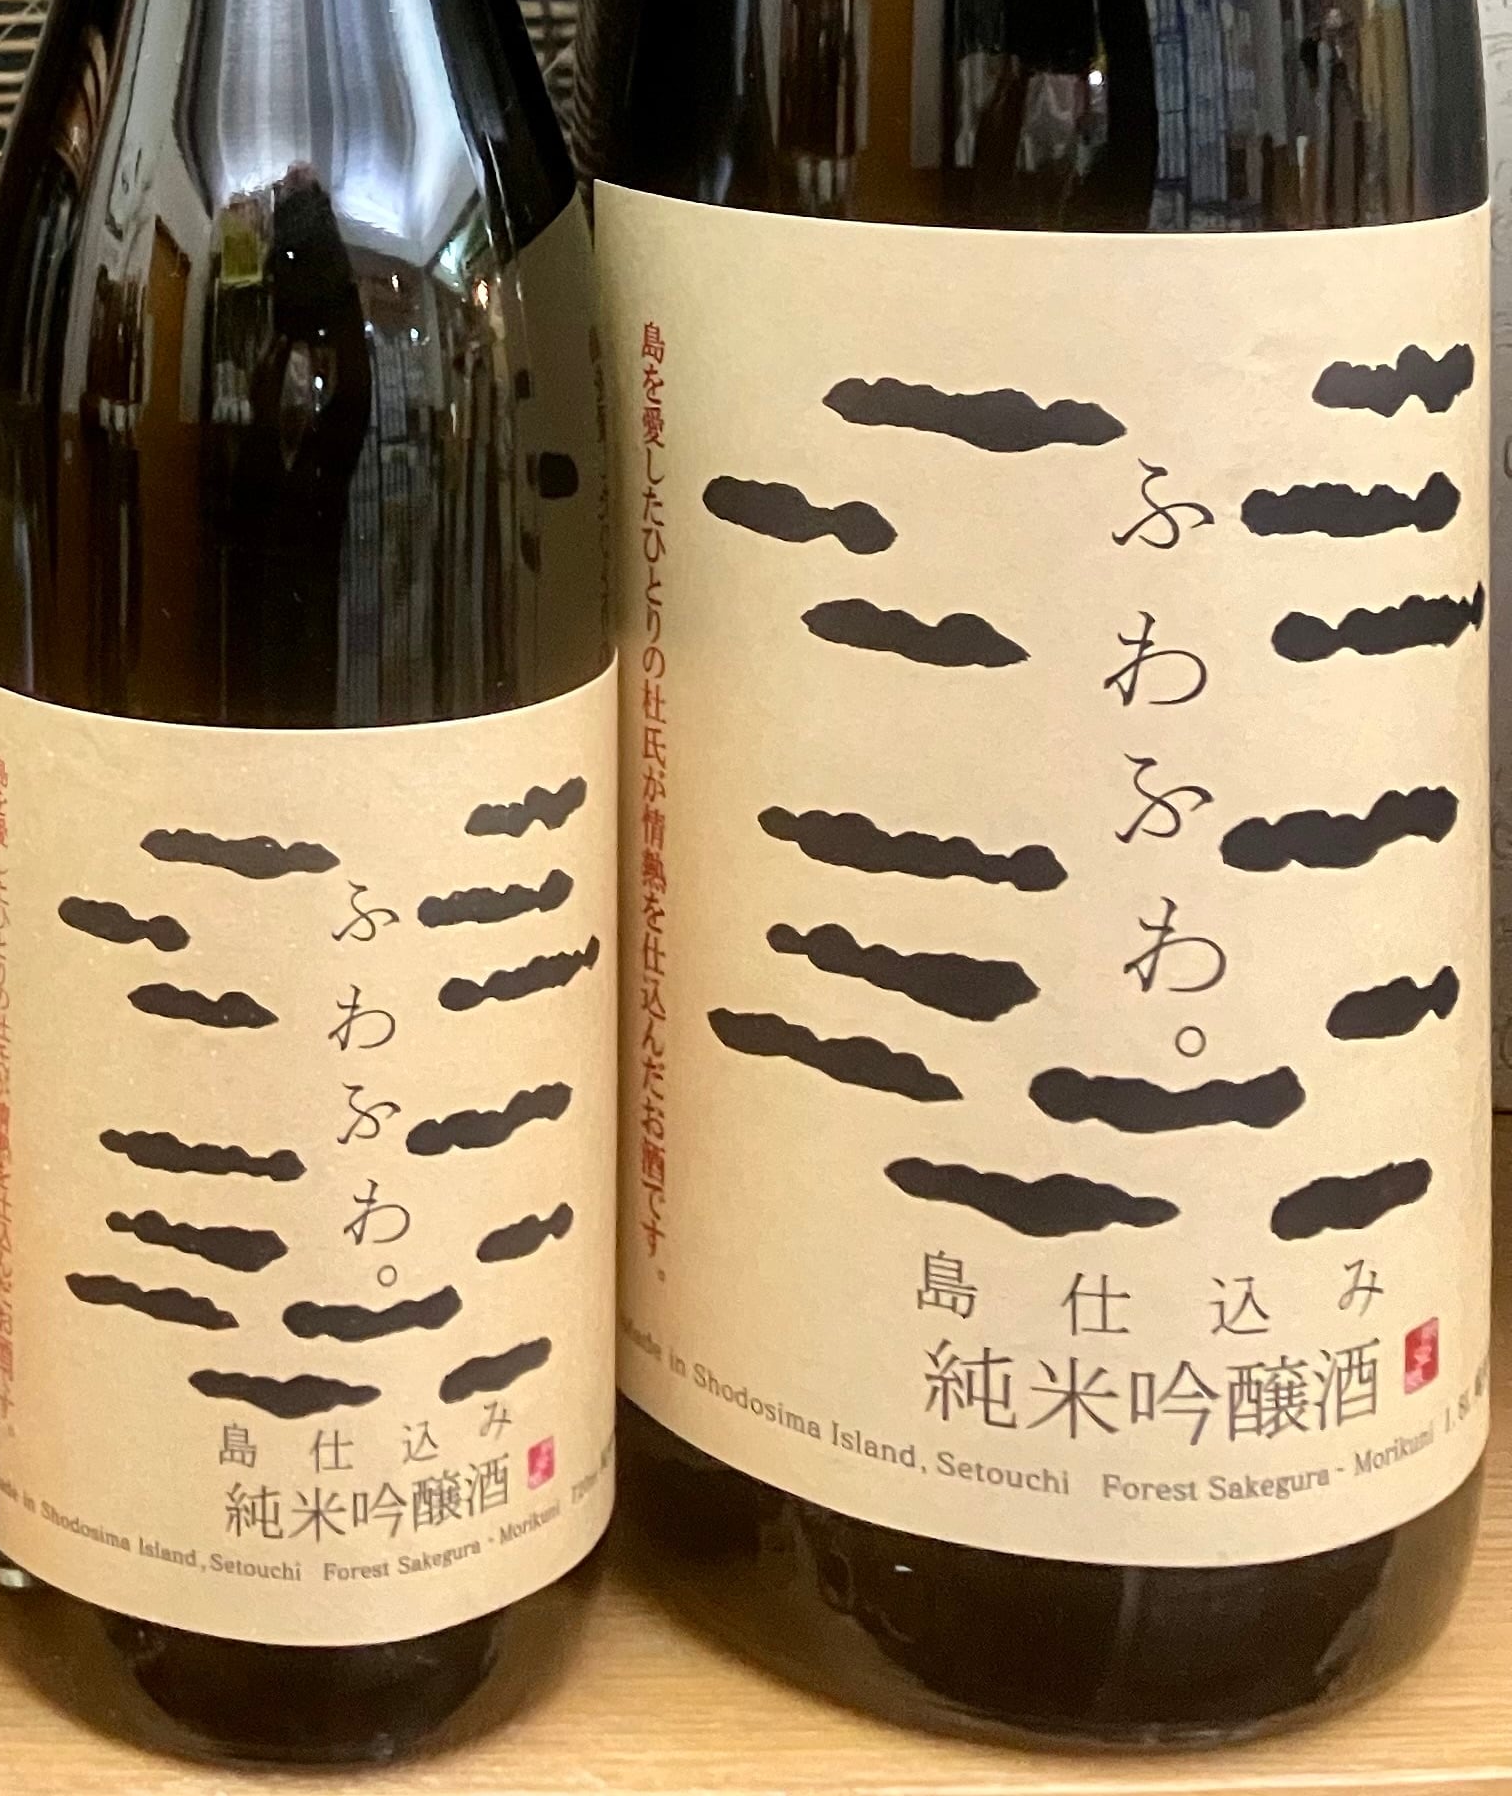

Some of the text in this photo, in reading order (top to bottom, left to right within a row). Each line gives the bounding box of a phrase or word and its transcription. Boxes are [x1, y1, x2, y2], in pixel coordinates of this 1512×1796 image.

[693, 1362, 822, 1440] Shodosima
[936, 1451, 1070, 1496] Setouchi
[1102, 1472, 1199, 1502] Forest
[1208, 1467, 1330, 1500] Sakegura
[925, 1337, 1381, 1446] 純米吟醸酒
[40, 1499, 131, 1553] Shodosima
[210, 1552, 302, 1583] Setouchi
[323, 1561, 390, 1581] Forest
[398, 1539, 482, 1576] Sakegura
[225, 1452, 509, 1543] 純米吟醸酒
